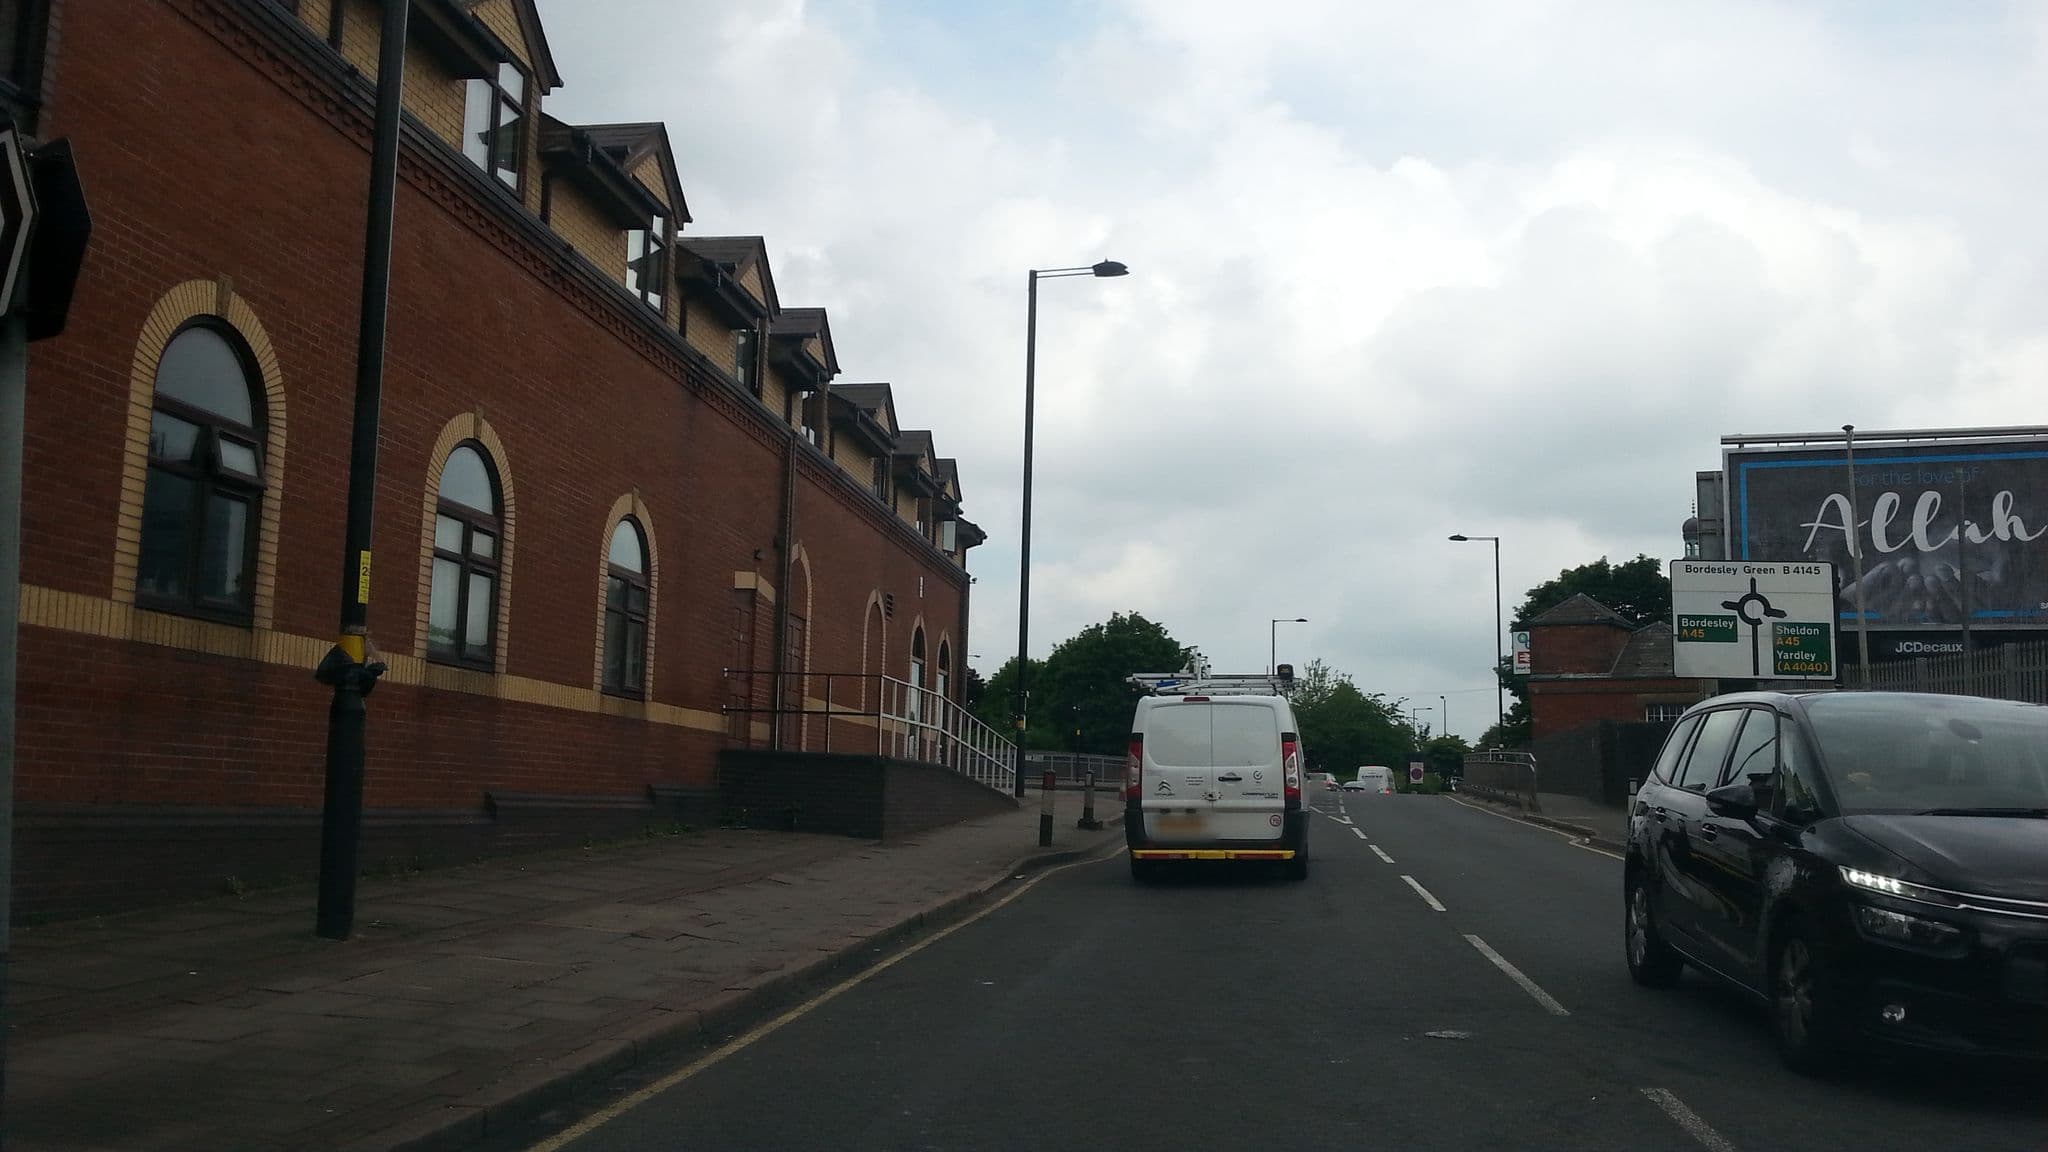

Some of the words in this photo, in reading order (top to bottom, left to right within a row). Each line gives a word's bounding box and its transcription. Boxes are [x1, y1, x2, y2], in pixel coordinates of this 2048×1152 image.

[1685, 564, 1738, 576] Bordesley
[1743, 565, 1776, 575] Green
[1681, 617, 1735, 630] Bordesley
[1776, 625, 1820, 636] Sheldon
[1895, 641, 1963, 653] JCDecaux
[1776, 649, 1817, 662] Yardley
[1776, 661, 1829, 673] (A4040)
